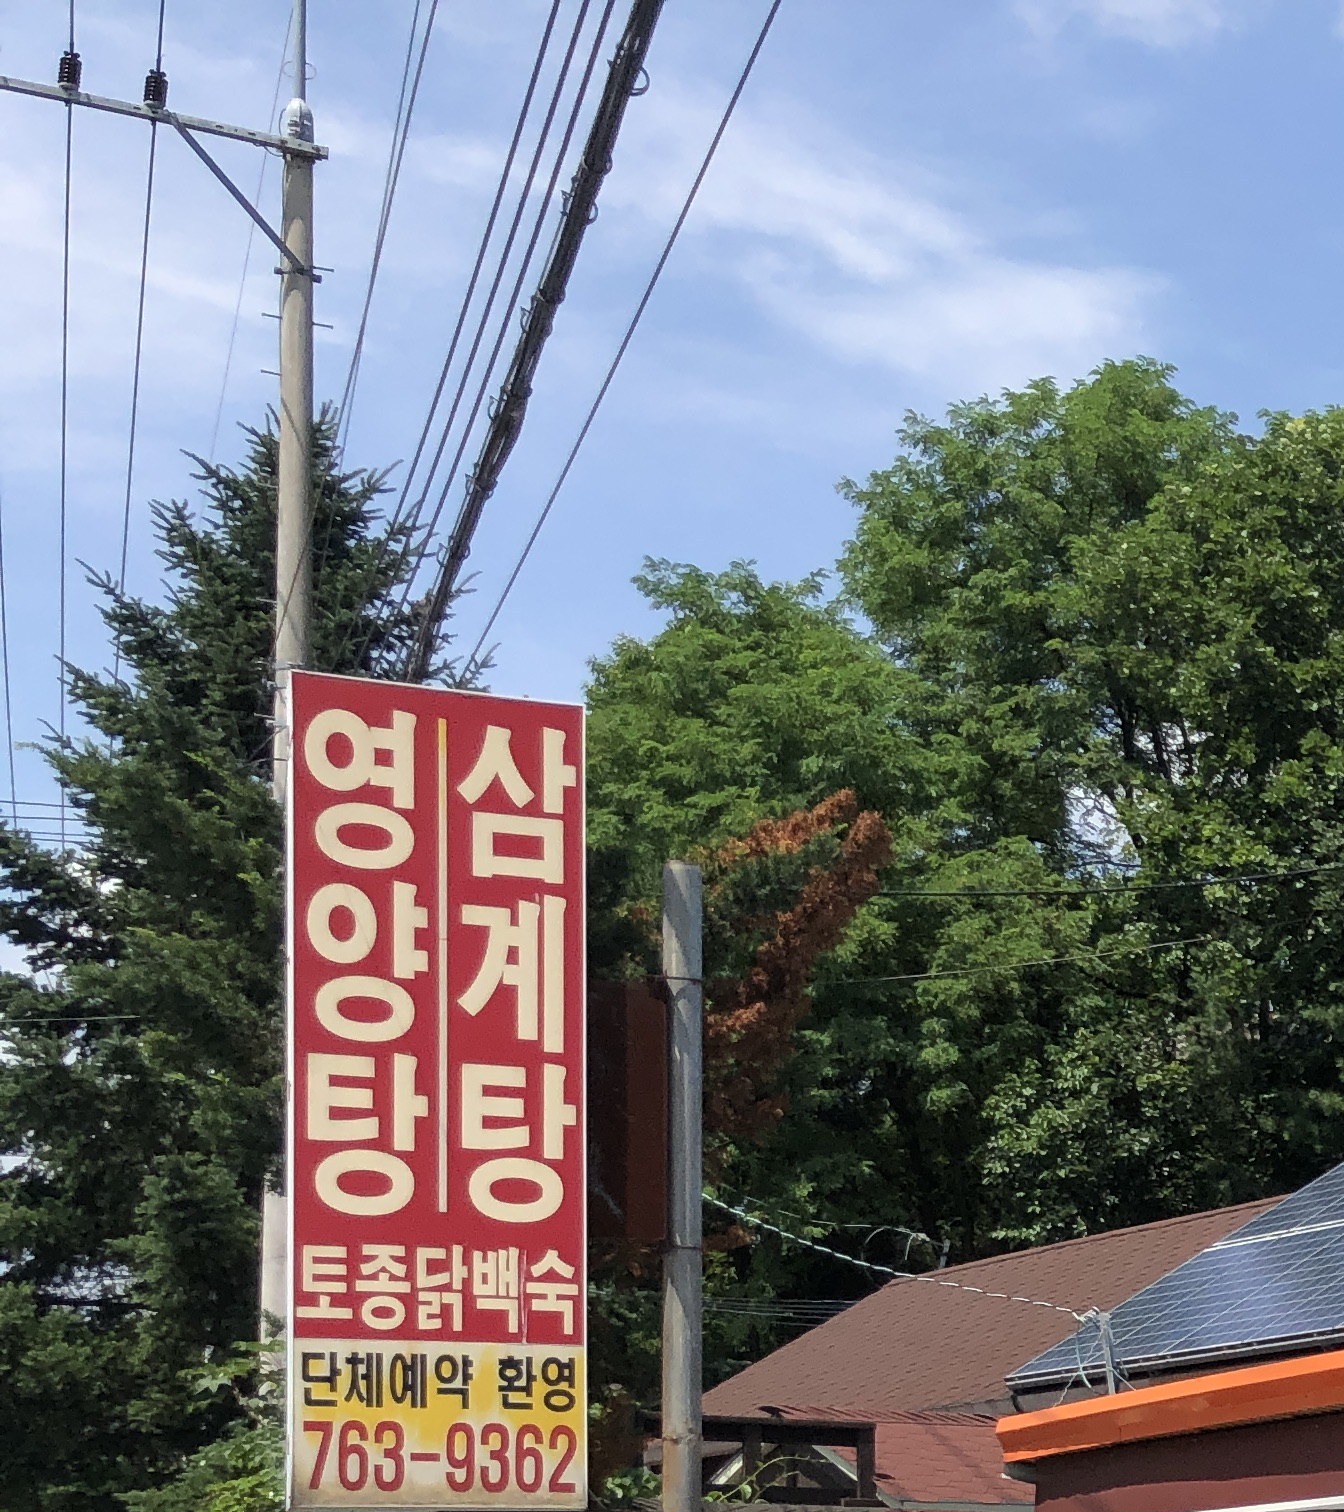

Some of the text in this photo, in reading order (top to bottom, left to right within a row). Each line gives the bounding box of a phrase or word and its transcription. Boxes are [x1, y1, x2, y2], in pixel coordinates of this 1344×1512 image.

[303, 708, 429, 1216] 영양탕
[456, 724, 577, 1223] 삼계탕
[296, 1244, 579, 1335] 토종닭백숙
[301, 1351, 577, 1413] 단체예약 환영
[302, 1419, 578, 1494] 763-9362
